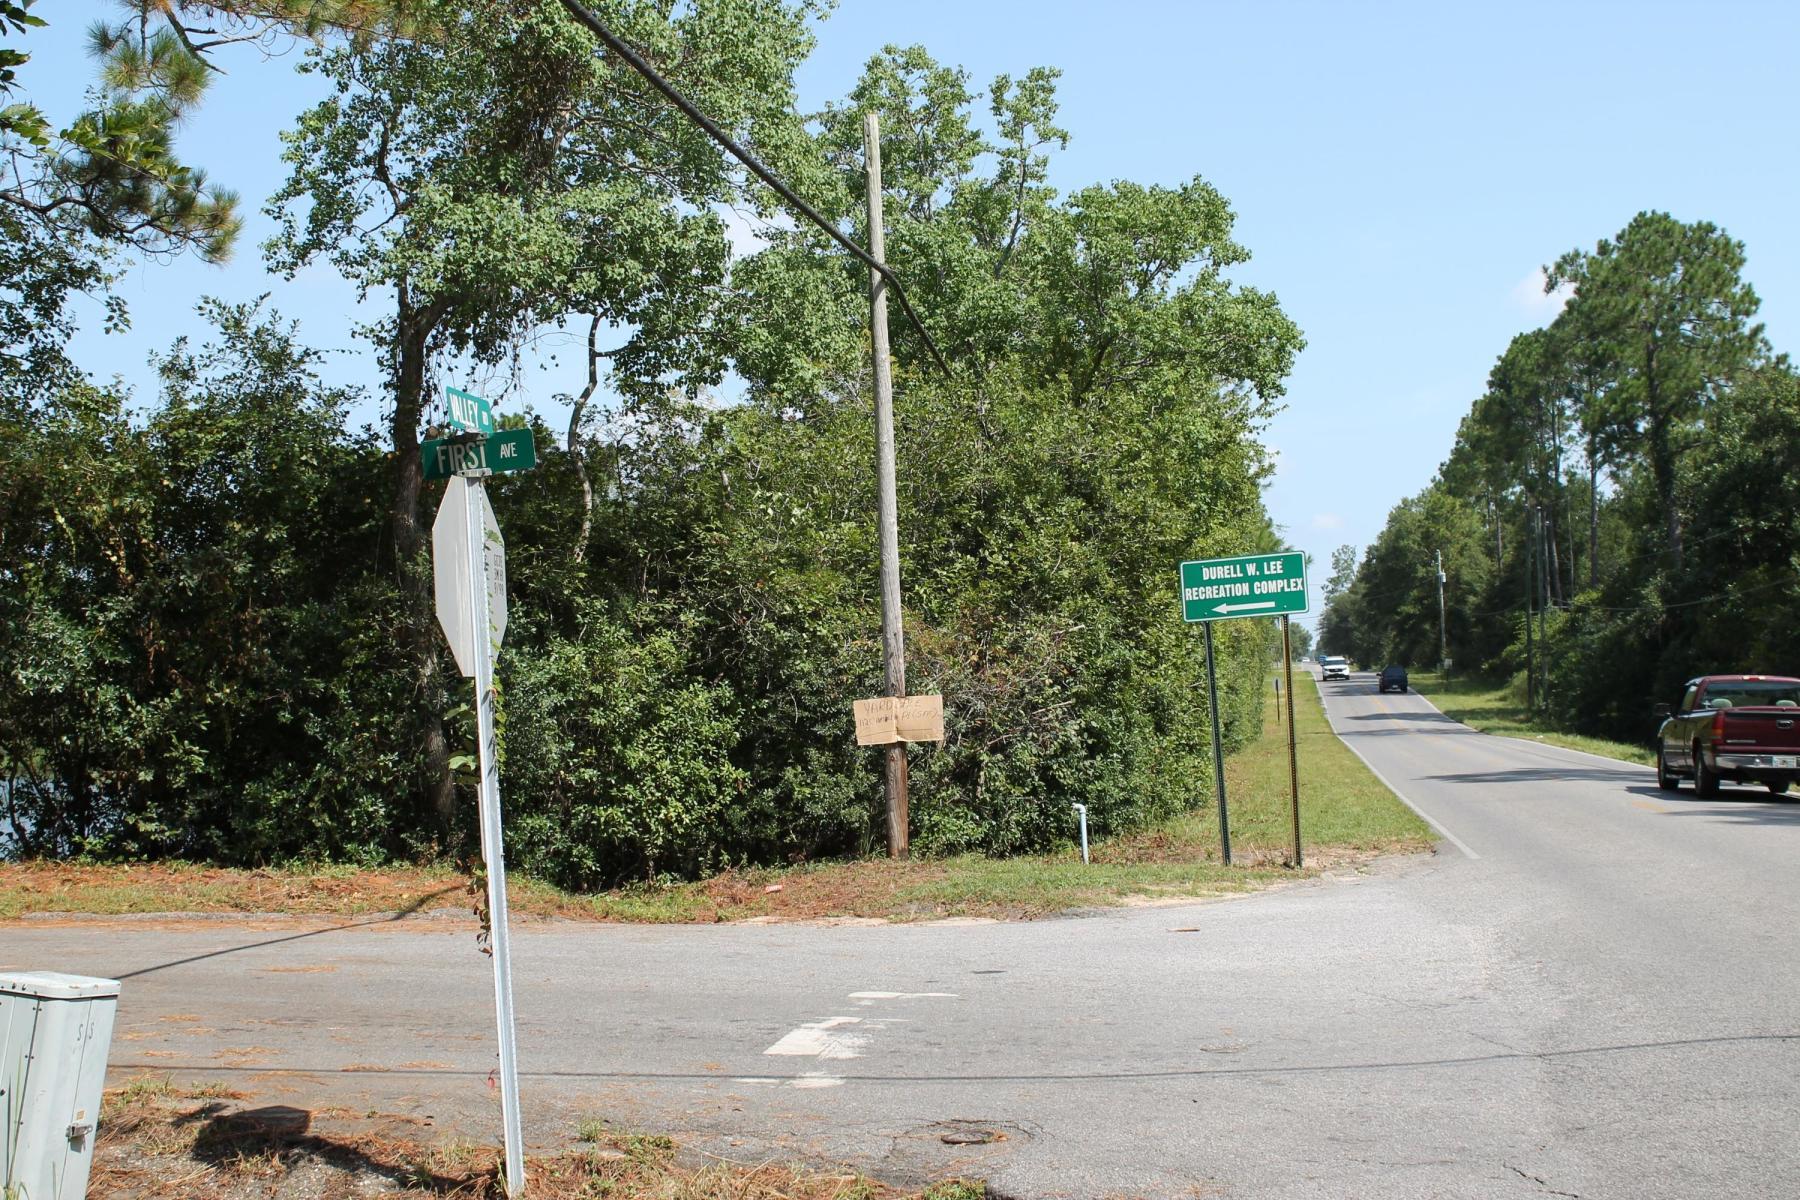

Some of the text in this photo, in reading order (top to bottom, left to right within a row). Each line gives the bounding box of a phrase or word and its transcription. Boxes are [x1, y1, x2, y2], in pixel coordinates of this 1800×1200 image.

[449, 393, 479, 428] VALLEY
[436, 440, 518, 474] FIRST AVE
[1202, 560, 1284, 581] DURELL W. LEE
[1185, 577, 1304, 601] RECREATION COMPLEX
[863, 700, 892, 713] YARD
